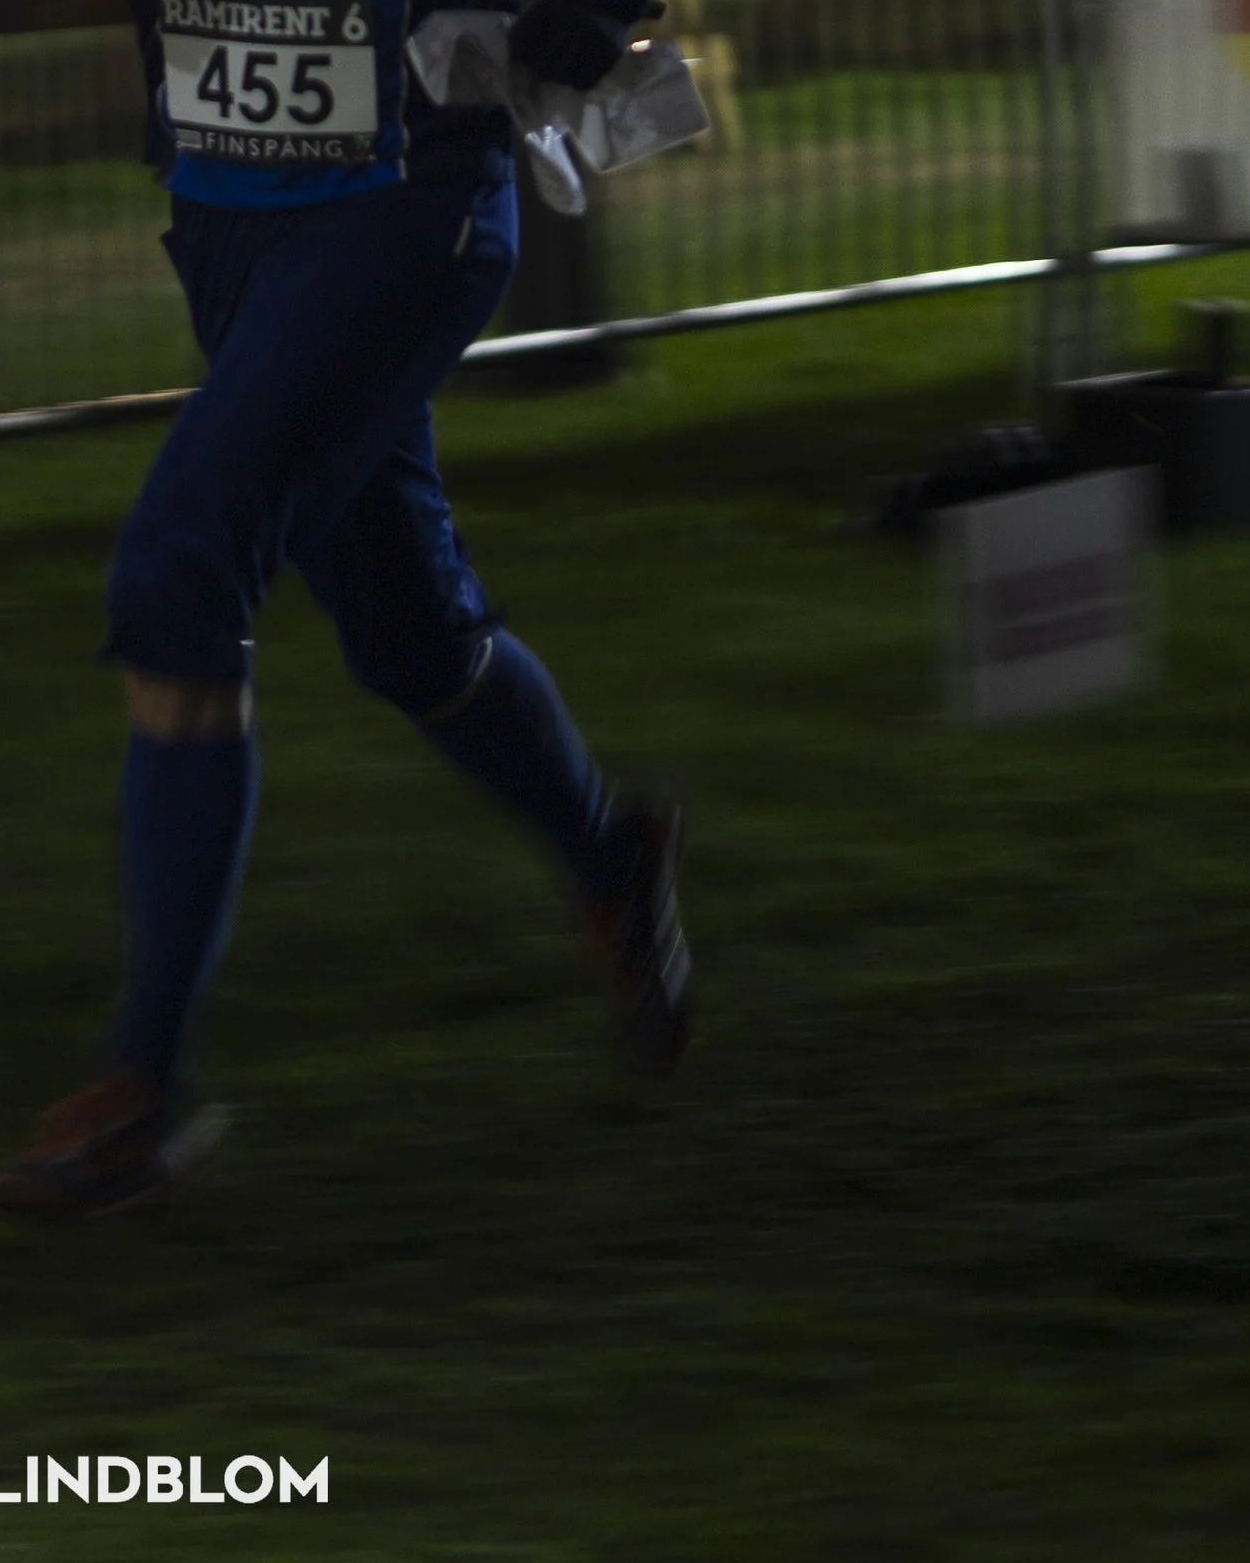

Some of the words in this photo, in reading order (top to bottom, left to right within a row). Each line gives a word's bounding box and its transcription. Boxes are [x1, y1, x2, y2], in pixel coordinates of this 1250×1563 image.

[341, 2, 368, 42] 6
[197, 45, 334, 125] 455
[205, 132, 344, 158] FINSPÅNG
